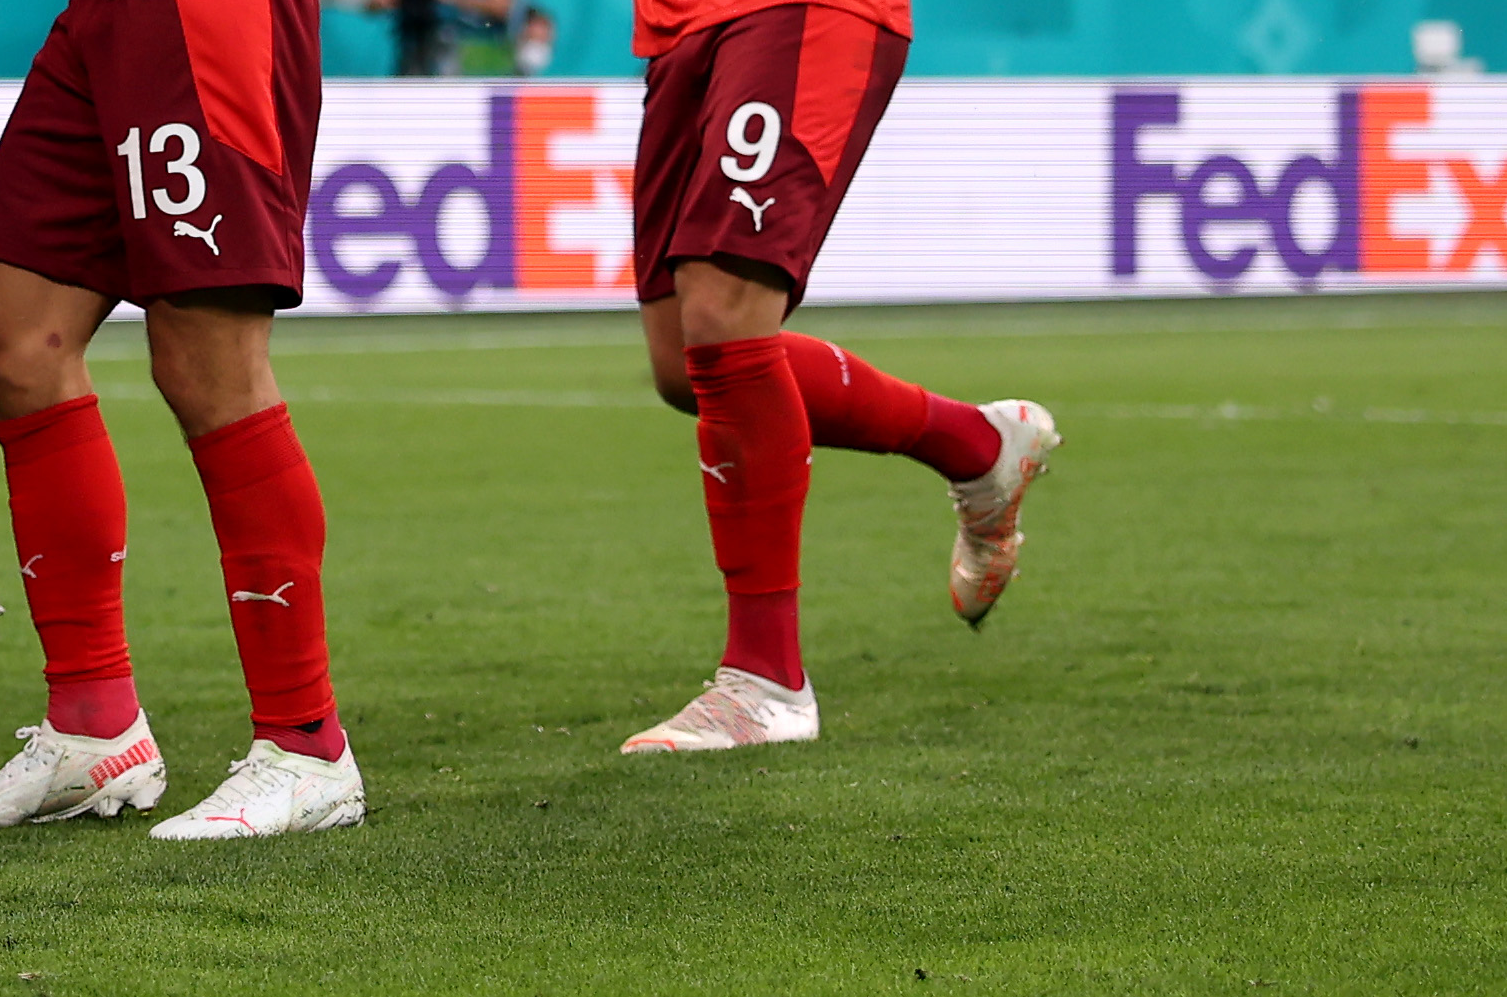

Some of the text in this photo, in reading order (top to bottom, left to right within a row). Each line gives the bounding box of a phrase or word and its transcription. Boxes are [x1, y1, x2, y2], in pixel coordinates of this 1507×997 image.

[117, 123, 206, 219] 13
[309, 94, 637, 300] edE
[720, 101, 782, 182] 9
[1109, 90, 1507, 282] FedEx
